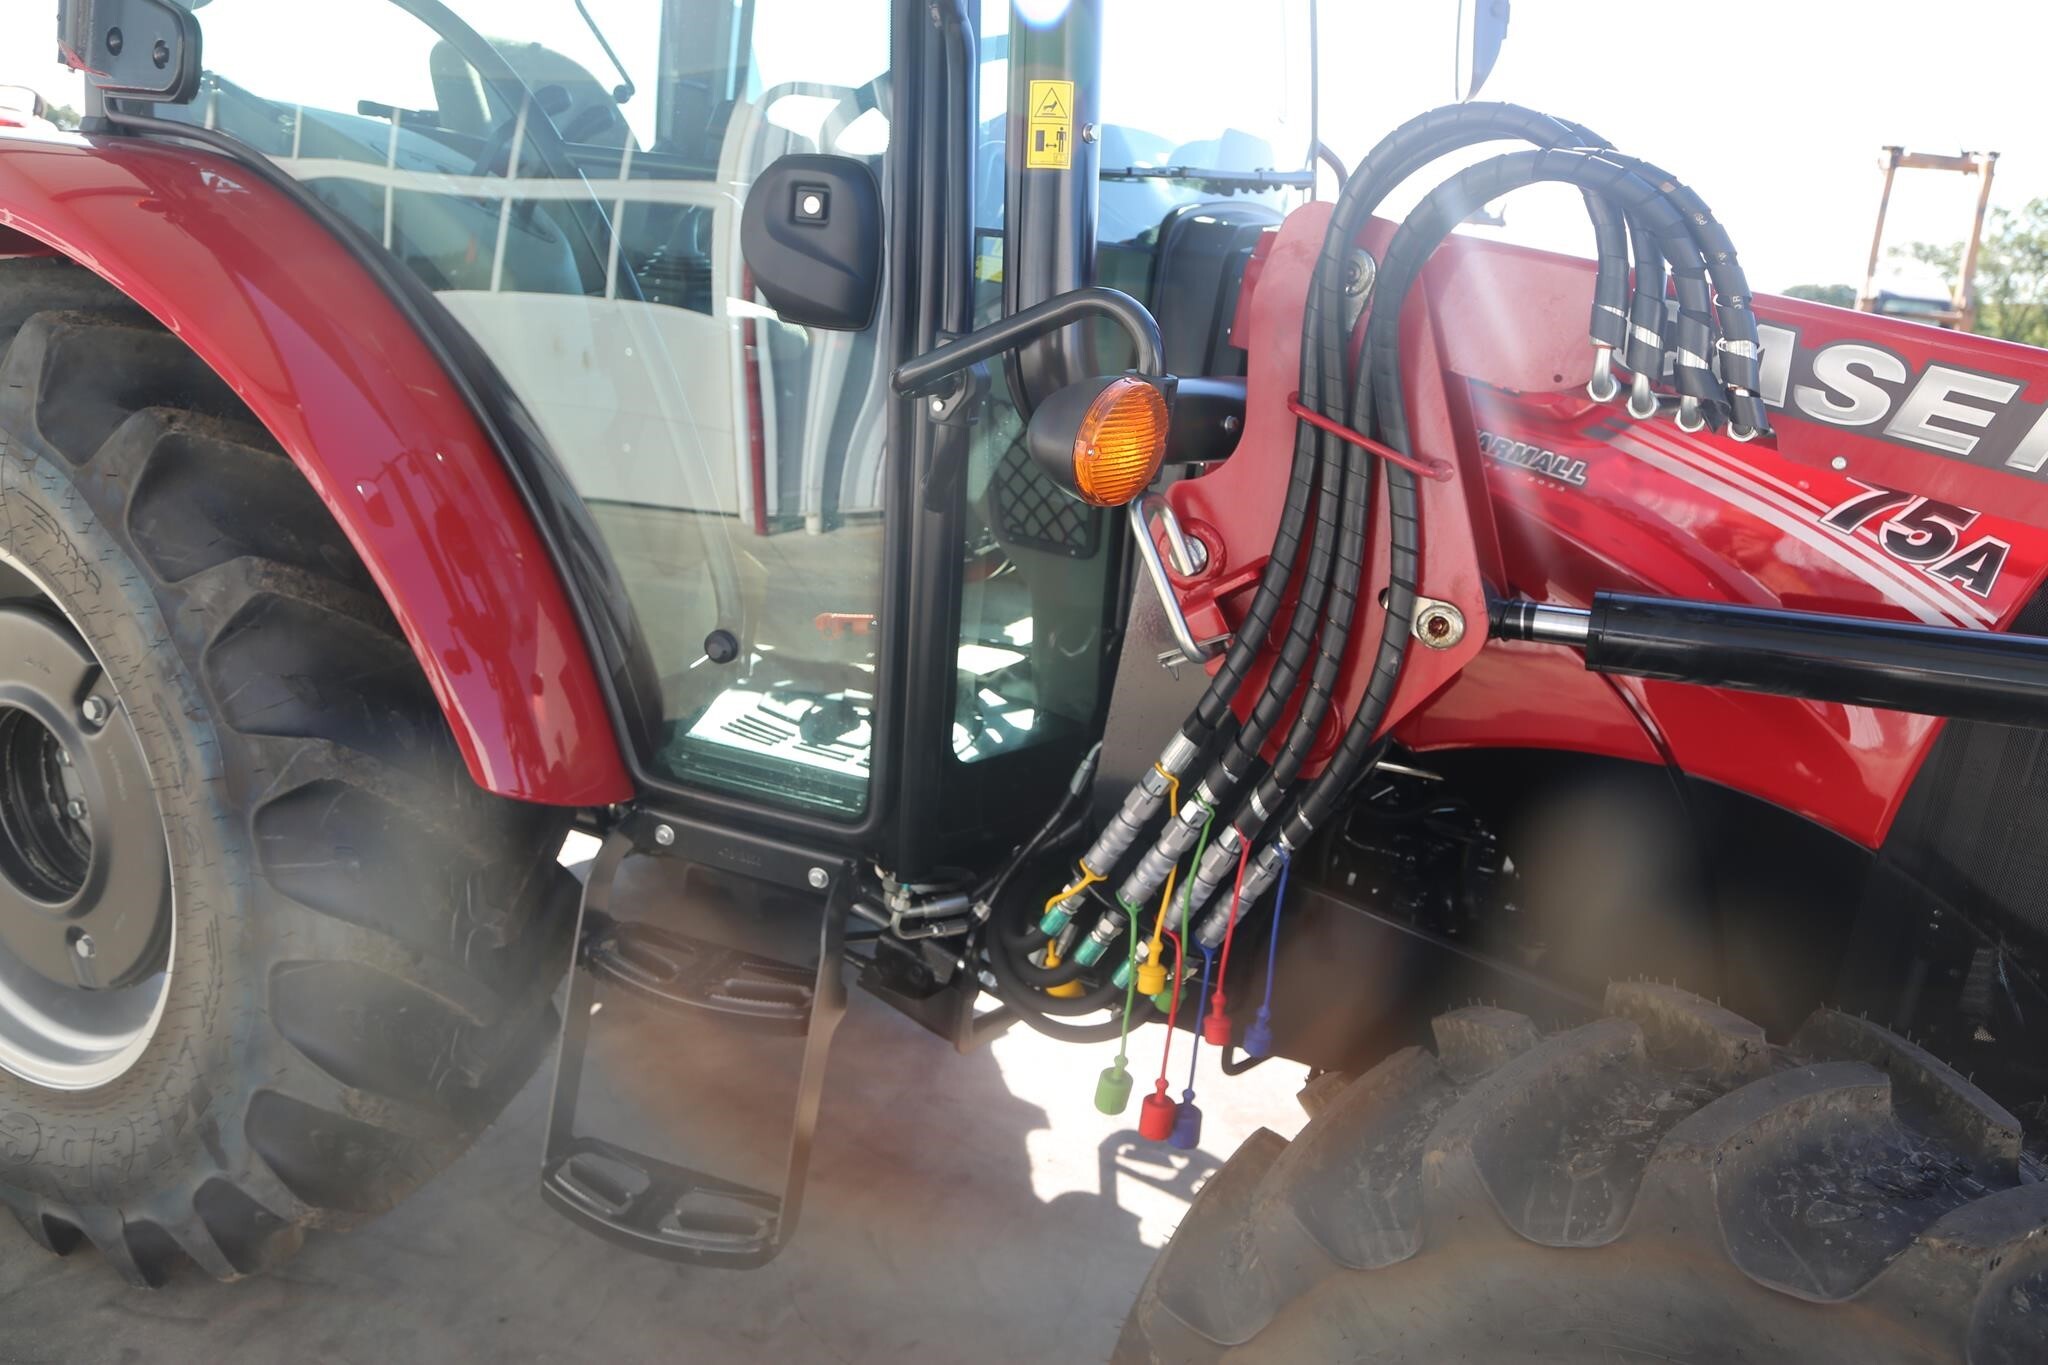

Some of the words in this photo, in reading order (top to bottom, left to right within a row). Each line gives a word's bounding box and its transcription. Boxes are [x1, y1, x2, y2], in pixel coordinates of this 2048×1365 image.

[1614, 298, 2020, 456] SE
[1477, 430, 1587, 486] ARMALL
[1817, 476, 2011, 598] 75A
